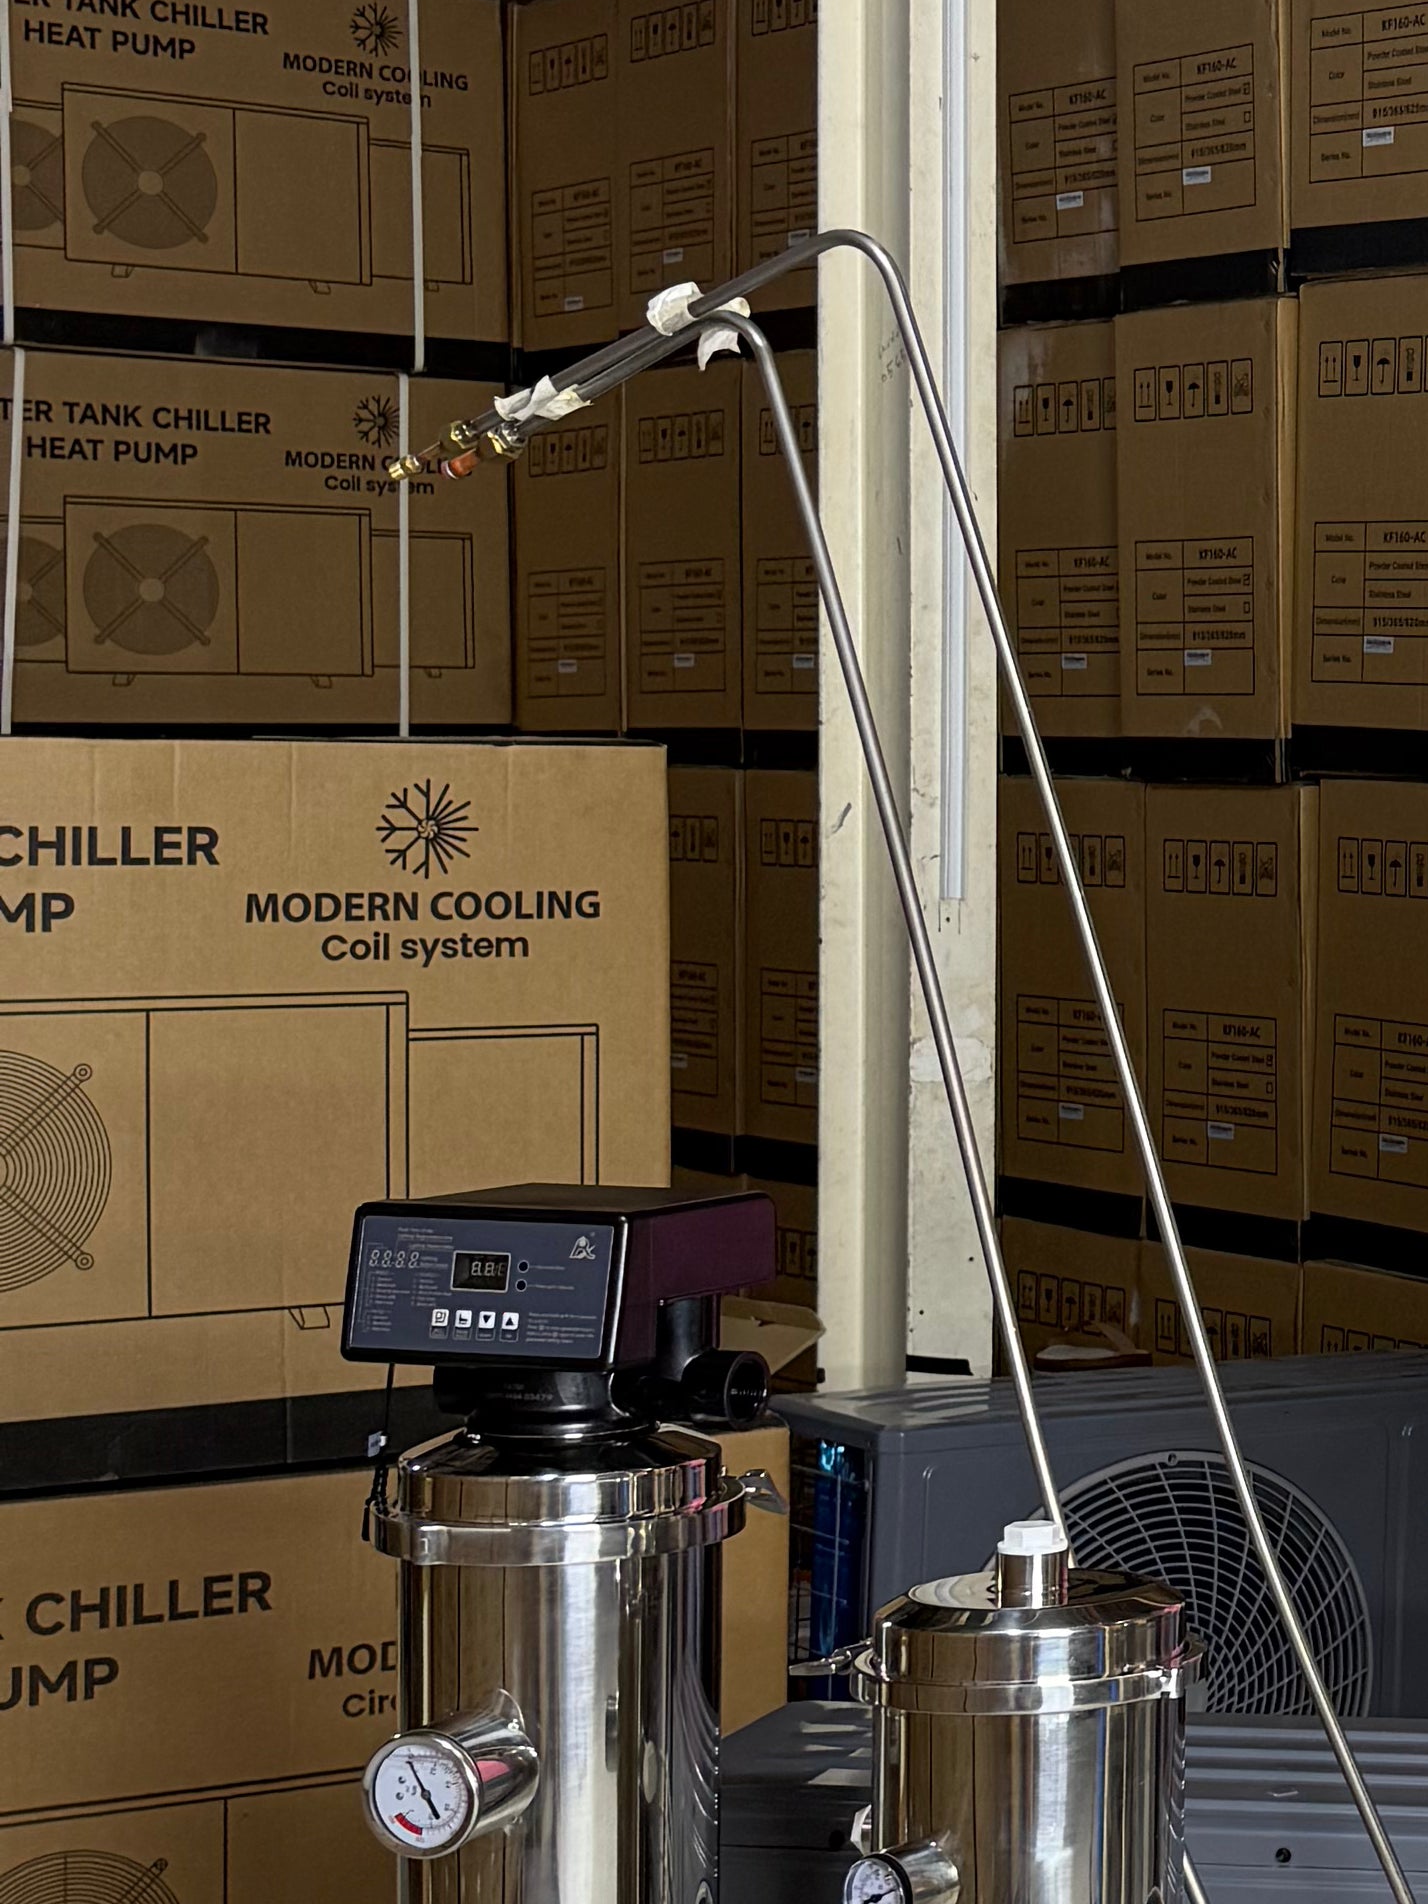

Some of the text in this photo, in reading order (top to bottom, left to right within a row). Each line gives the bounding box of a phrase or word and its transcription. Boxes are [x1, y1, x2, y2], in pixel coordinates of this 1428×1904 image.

[150, 0, 270, 36] CHILLER
[24, 19, 196, 61] HEAT PUMP
[283, 52, 373, 81] MODERN
[322, 81, 359, 100] Coil
[63, 401, 142, 427] TANK
[152, 407, 272, 435] CHILLER
[26, 436, 198, 466] HEAT PUMP
[285, 451, 376, 472] MODERN
[325, 475, 360, 492] Coil
[245, 890, 601, 923] MODERN COOLING
[321, 932, 530, 968] Coil system
[25, 1570, 273, 1636] CHILLER
